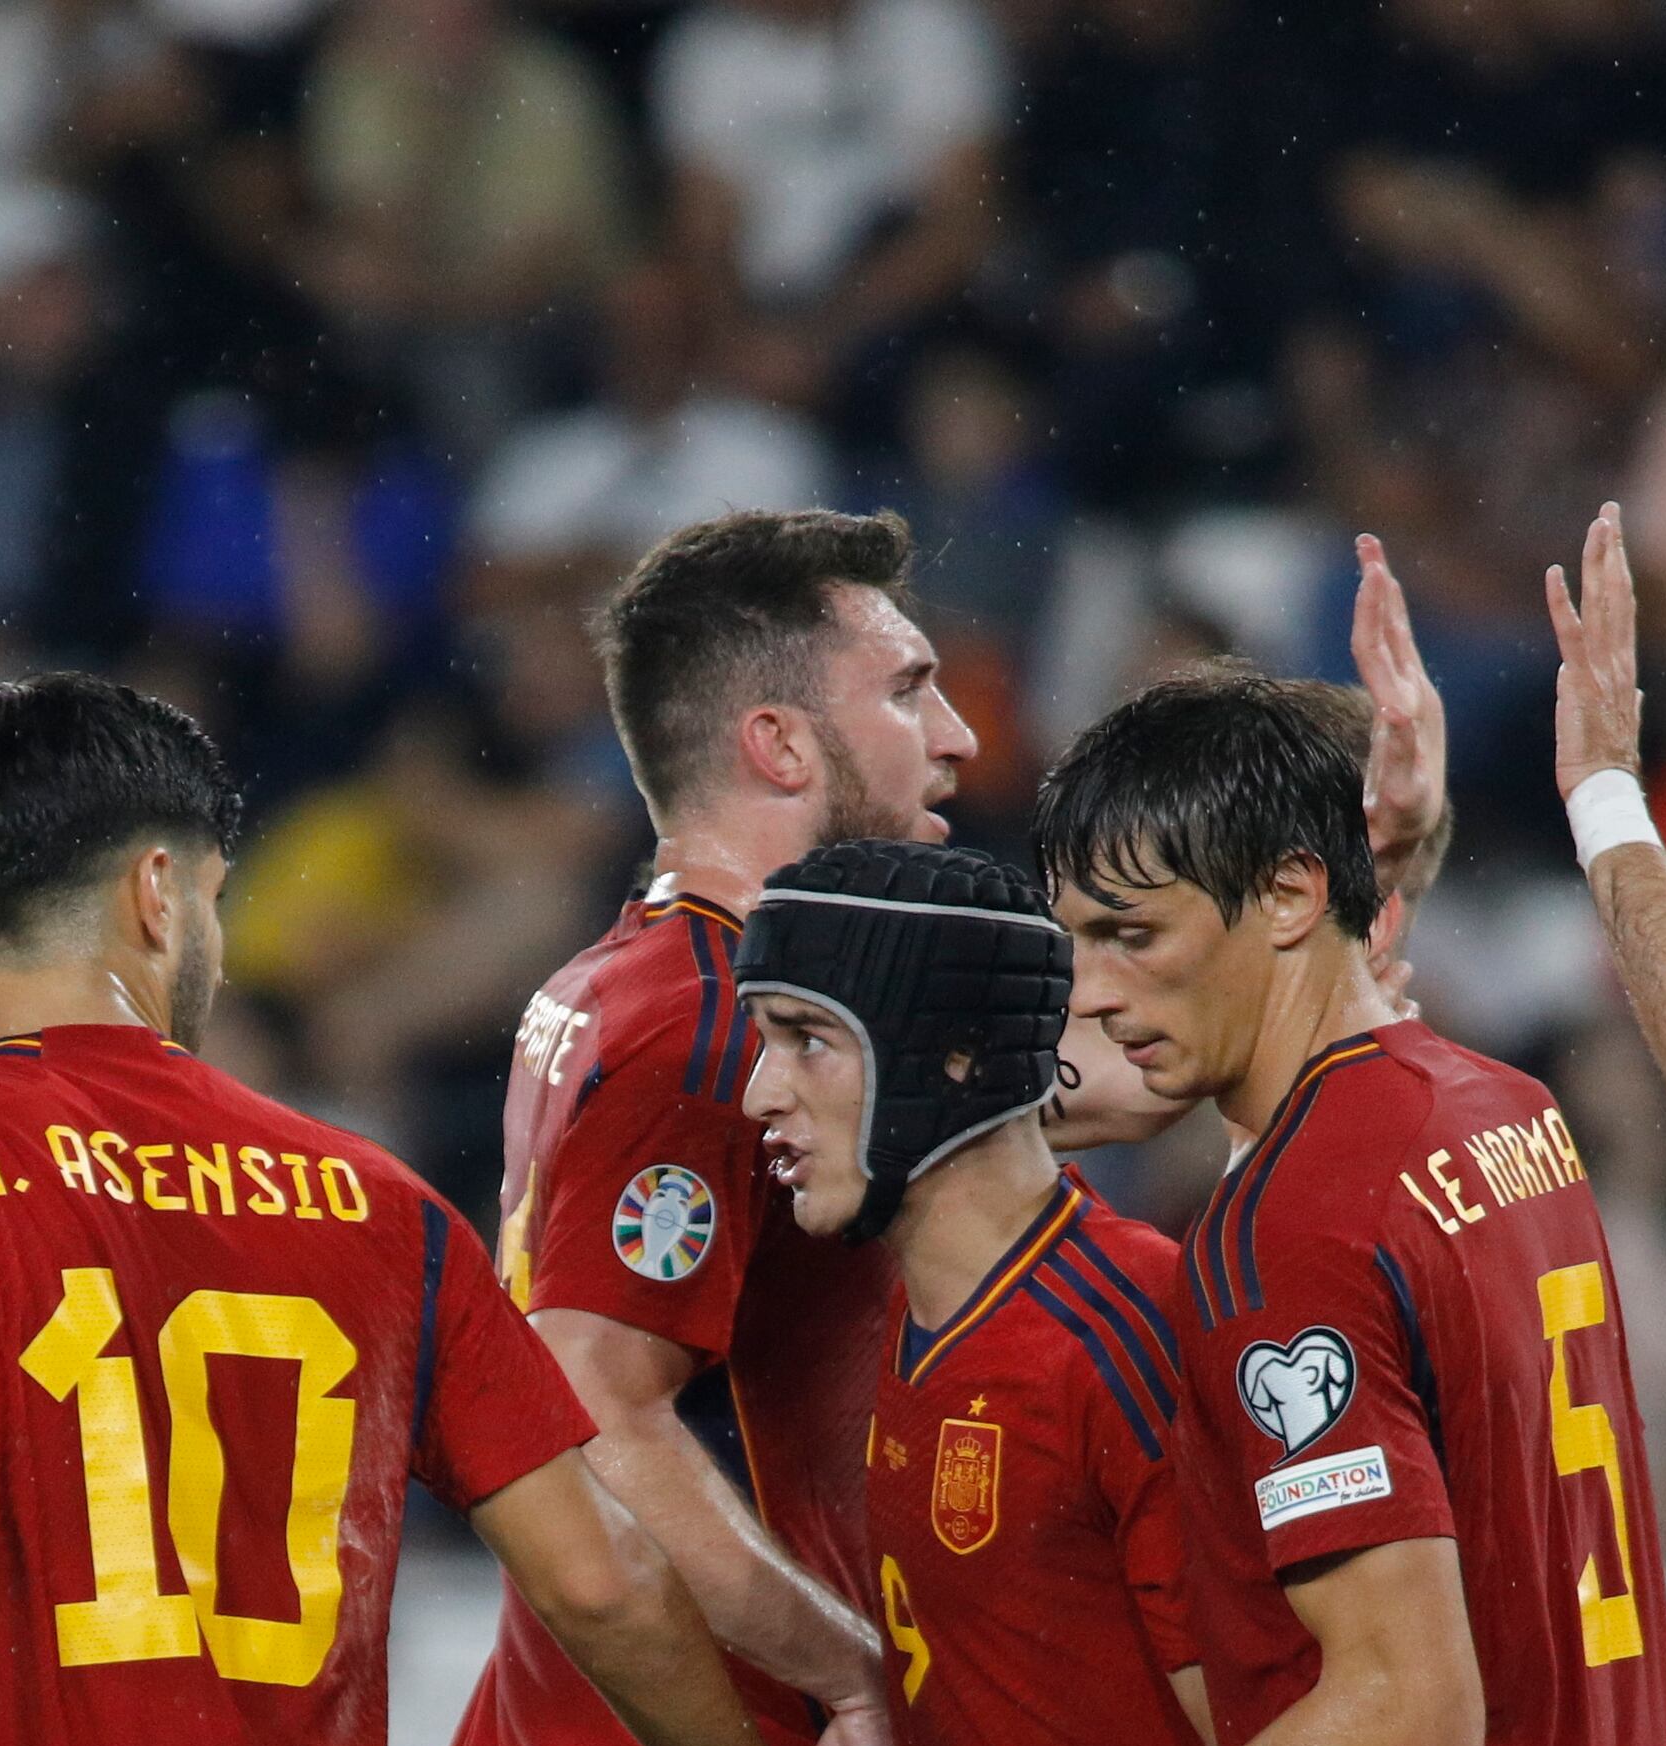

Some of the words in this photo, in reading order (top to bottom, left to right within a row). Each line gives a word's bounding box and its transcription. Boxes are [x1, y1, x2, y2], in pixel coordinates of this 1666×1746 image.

[45, 1125, 369, 1223] ASENSIO
[1400, 1149, 1486, 1236] LE
[1464, 1106, 1589, 1209] NORMA
[19, 1267, 358, 1687] 10
[1537, 1261, 1643, 1668] 5
[880, 1554, 931, 1707] 9
